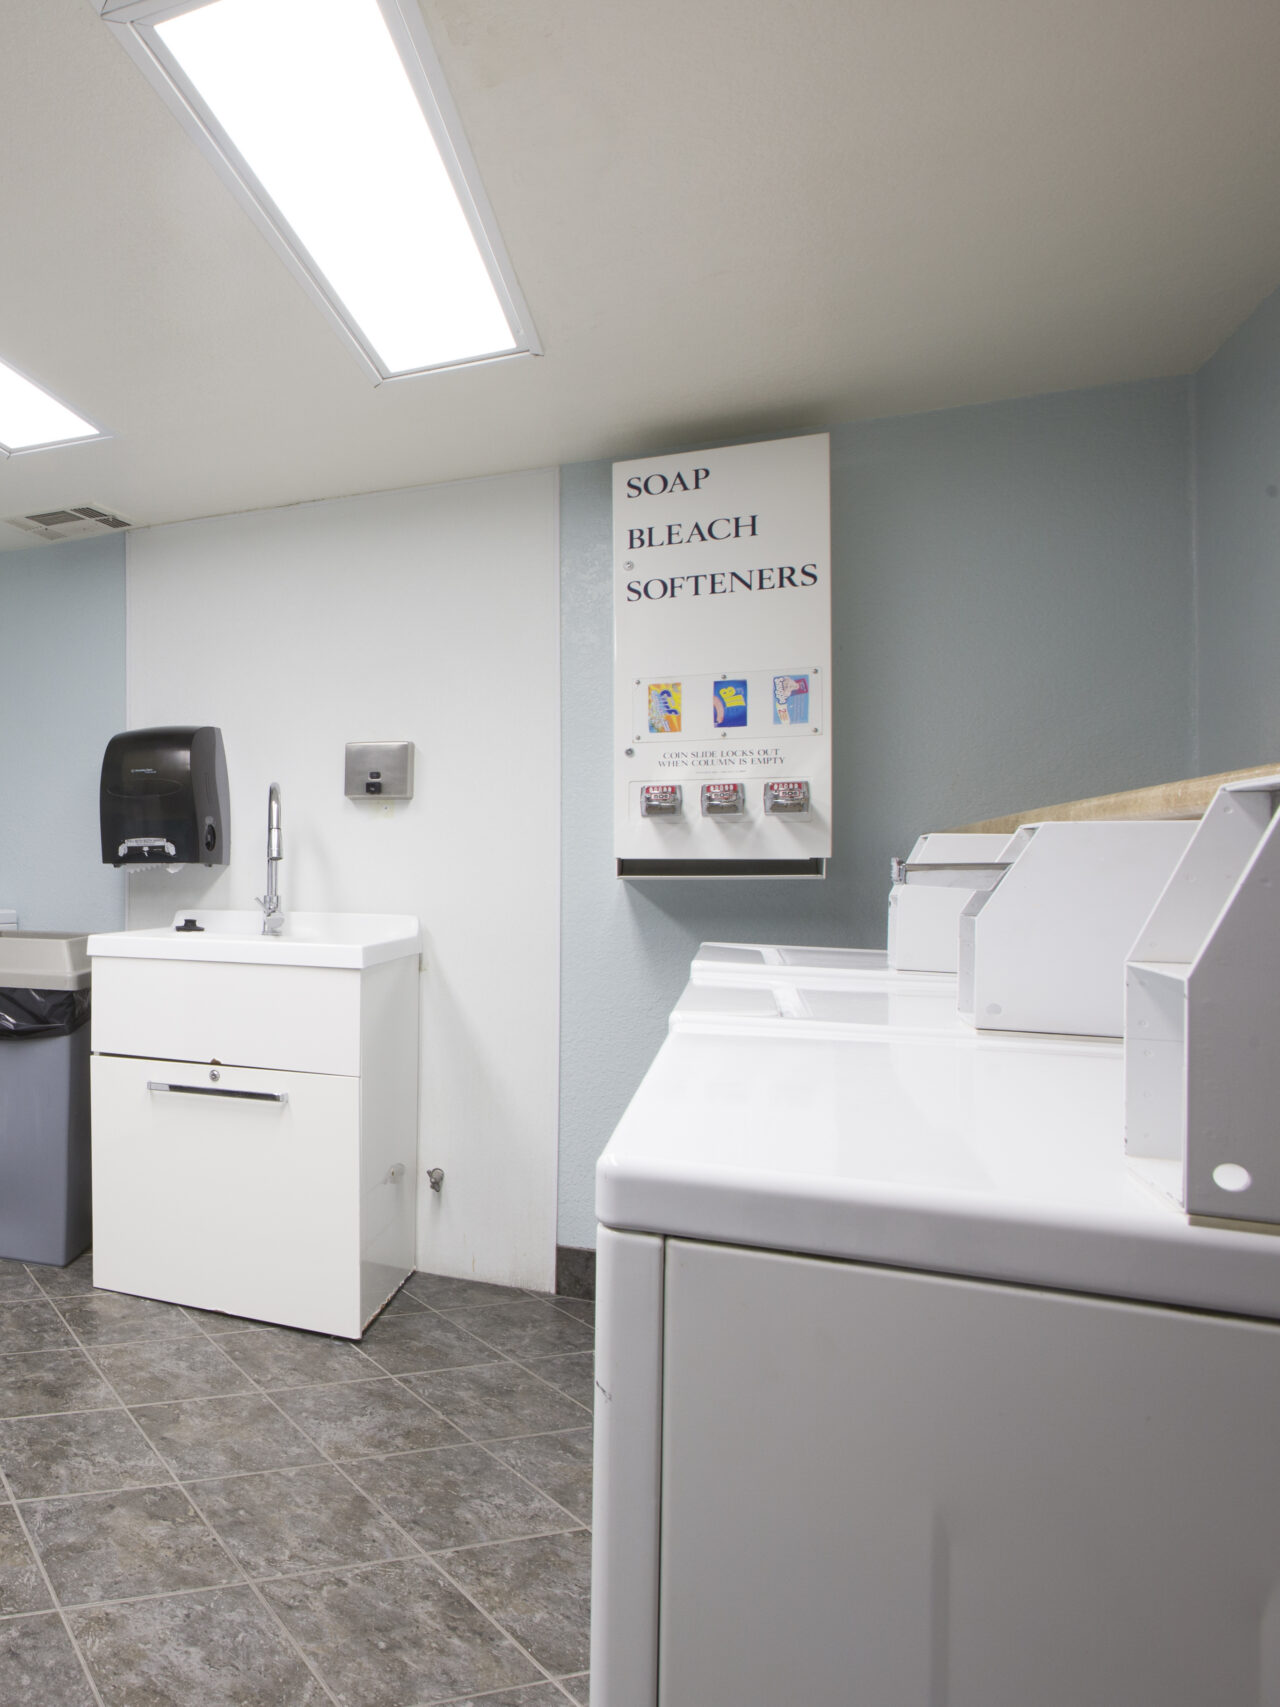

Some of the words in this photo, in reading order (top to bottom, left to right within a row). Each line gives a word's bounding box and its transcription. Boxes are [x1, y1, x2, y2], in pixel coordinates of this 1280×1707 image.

[626, 467, 711, 499] SOAP
[628, 514, 759, 549] BLEACH
[626, 563, 818, 602] SOFTENERS
[662, 751, 688, 759] COIN
[691, 750, 717, 759] SLIDE
[720, 749, 754, 758] LOCKS
[757, 748, 780, 756] OUT
[691, 758, 735, 766] COLUMN
[739, 757, 748, 765] IS
[750, 756, 785, 765] EMPTY
